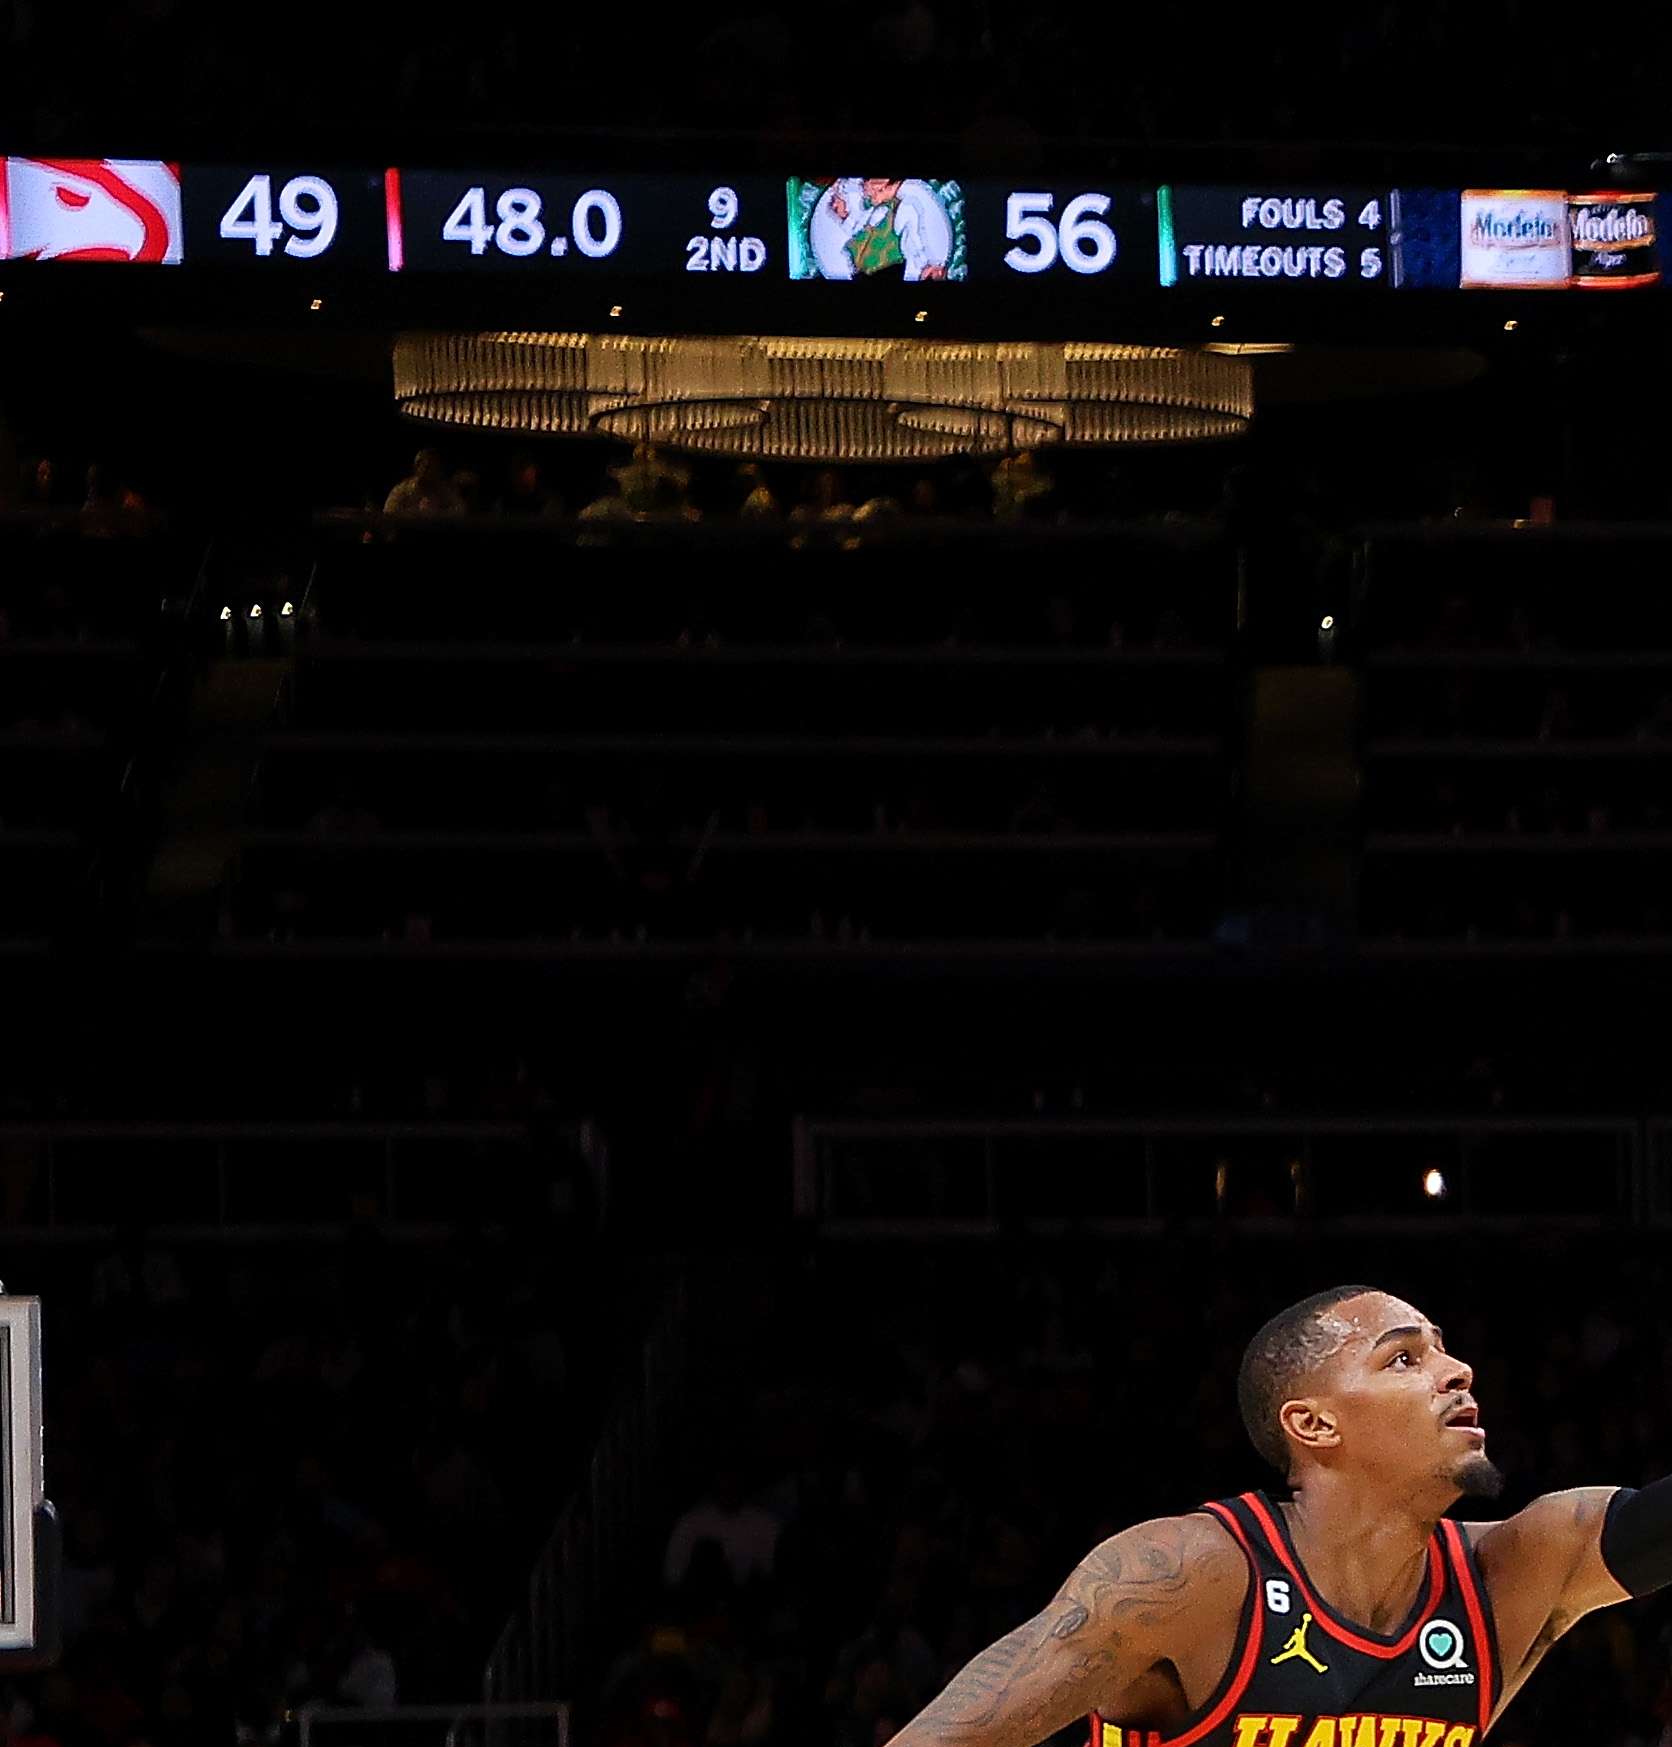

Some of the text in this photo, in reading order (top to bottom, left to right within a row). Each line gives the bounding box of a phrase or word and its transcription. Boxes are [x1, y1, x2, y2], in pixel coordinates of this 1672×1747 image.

[219, 174, 338, 258] 49
[442, 187, 622, 258] 48.0
[708, 187, 738, 229] 9
[1241, 197, 1381, 231] FOULS 4
[1004, 193, 1116, 274] 56
[685, 236, 766, 272] 2ND
[1183, 244, 1383, 279] TIMEOUTS 5
[1266, 1580, 1290, 1614] 6
[1413, 1672, 1475, 1686] sharecare
